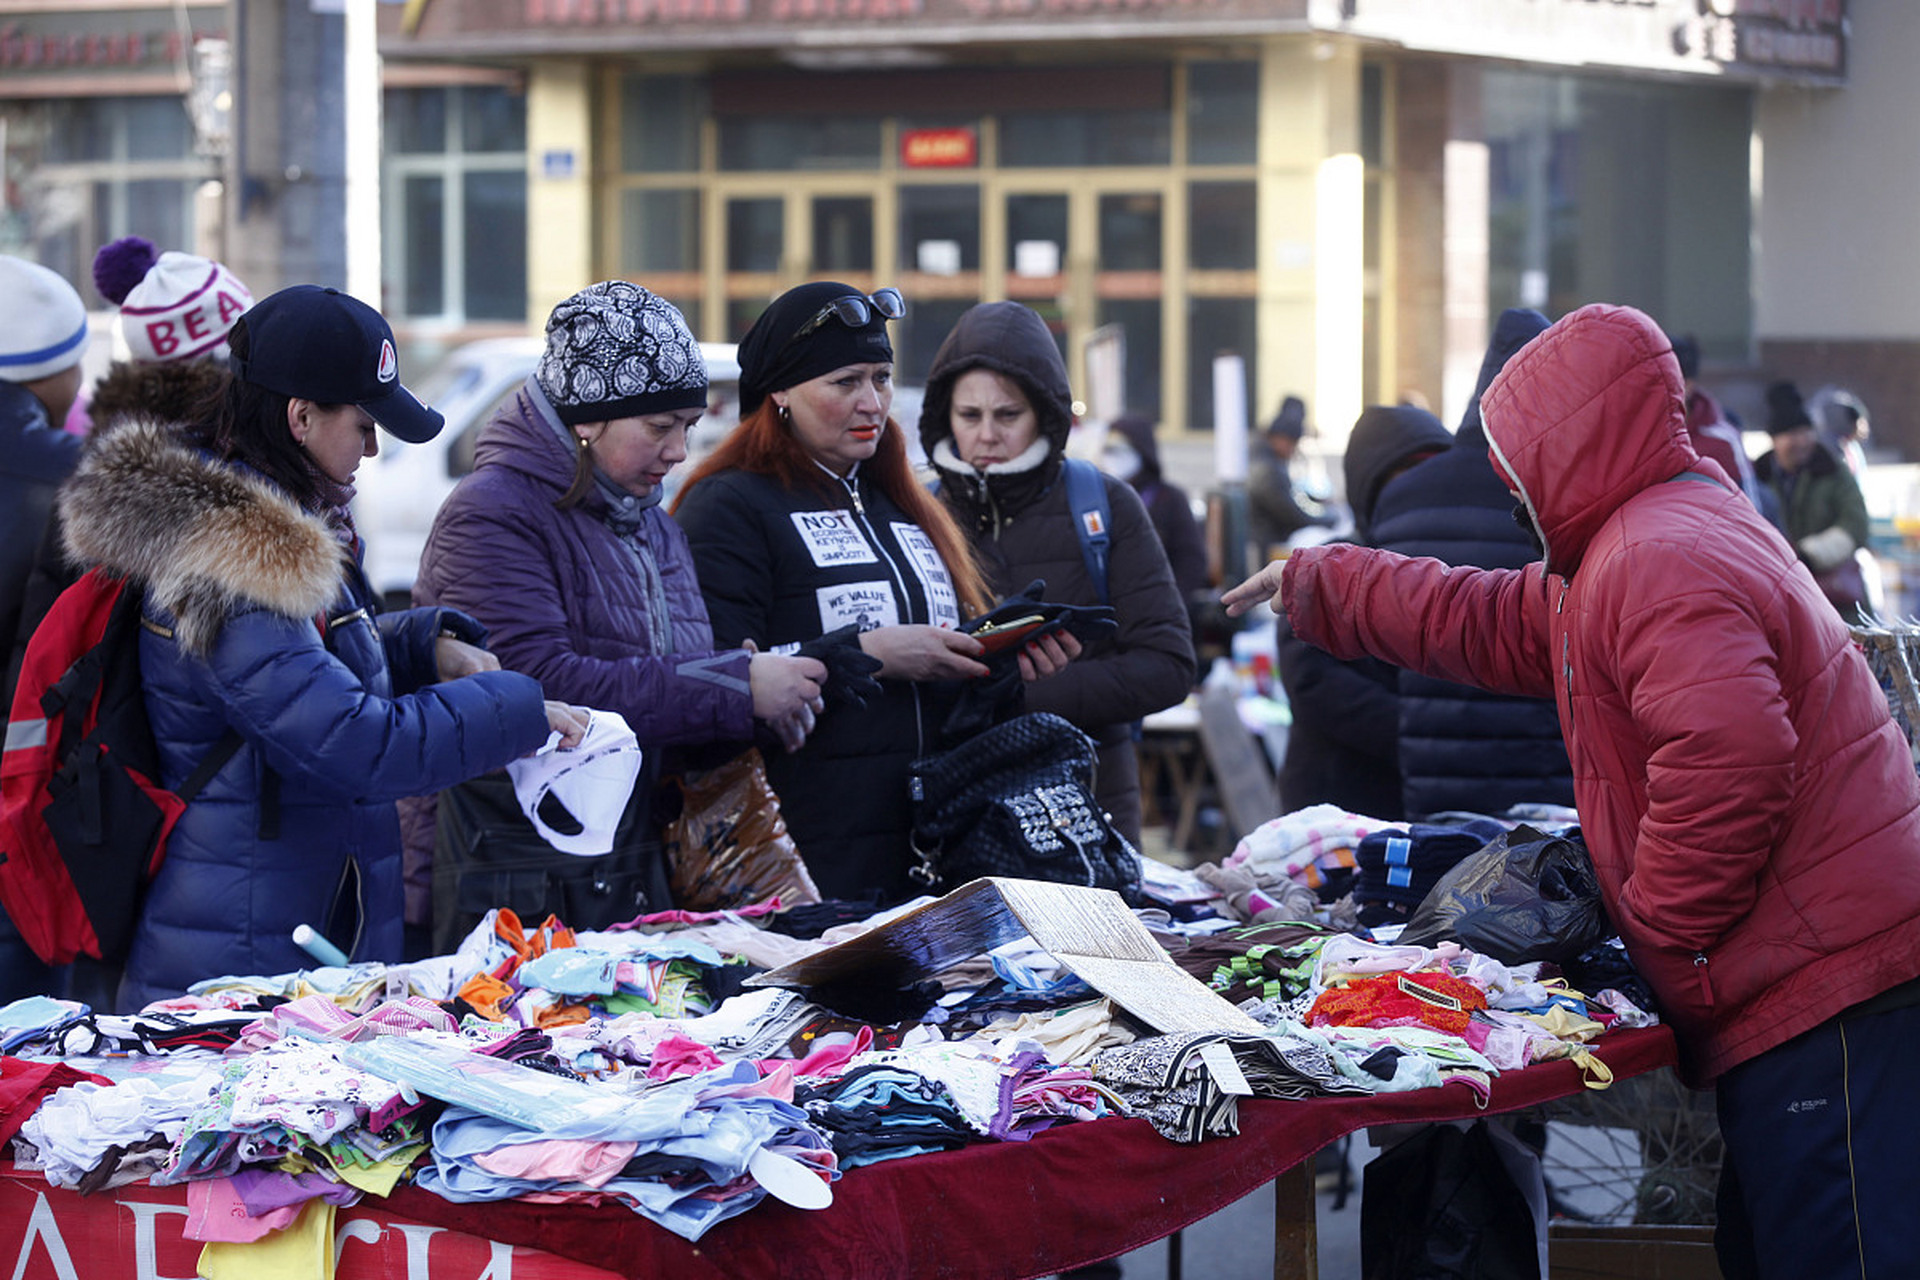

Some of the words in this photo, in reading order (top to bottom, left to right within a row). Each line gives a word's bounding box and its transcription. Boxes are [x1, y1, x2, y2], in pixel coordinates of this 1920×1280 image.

[801, 514, 848, 530] NOT
[828, 594, 846, 609] WE
[848, 590, 889, 604] VALUE
